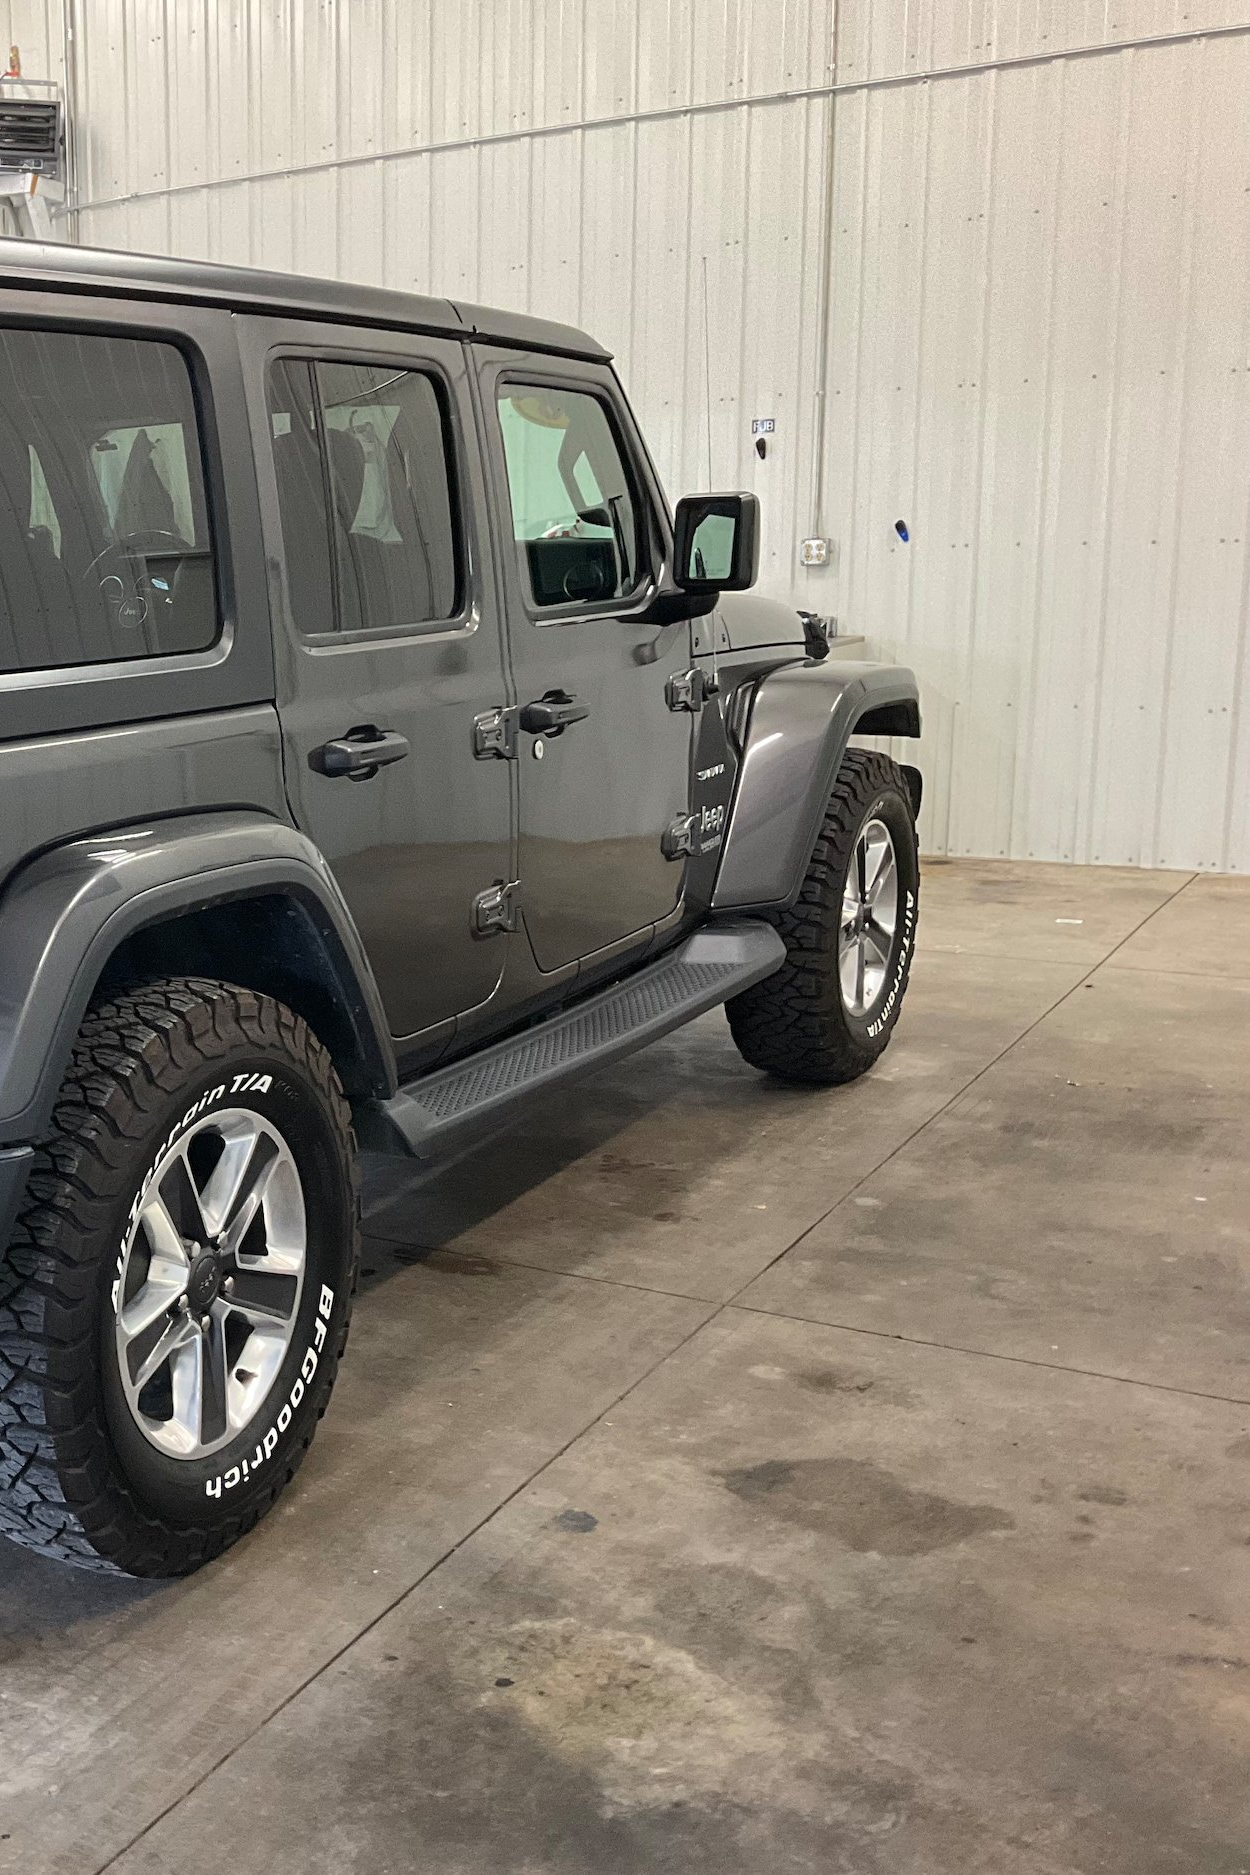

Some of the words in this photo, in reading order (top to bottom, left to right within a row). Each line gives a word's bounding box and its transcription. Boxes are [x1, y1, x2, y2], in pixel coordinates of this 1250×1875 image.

[882, 890, 914, 1020] All-Terrain
[230, 1073, 272, 1093] T/A
[205, 1283, 335, 1499] BFGoodrich
